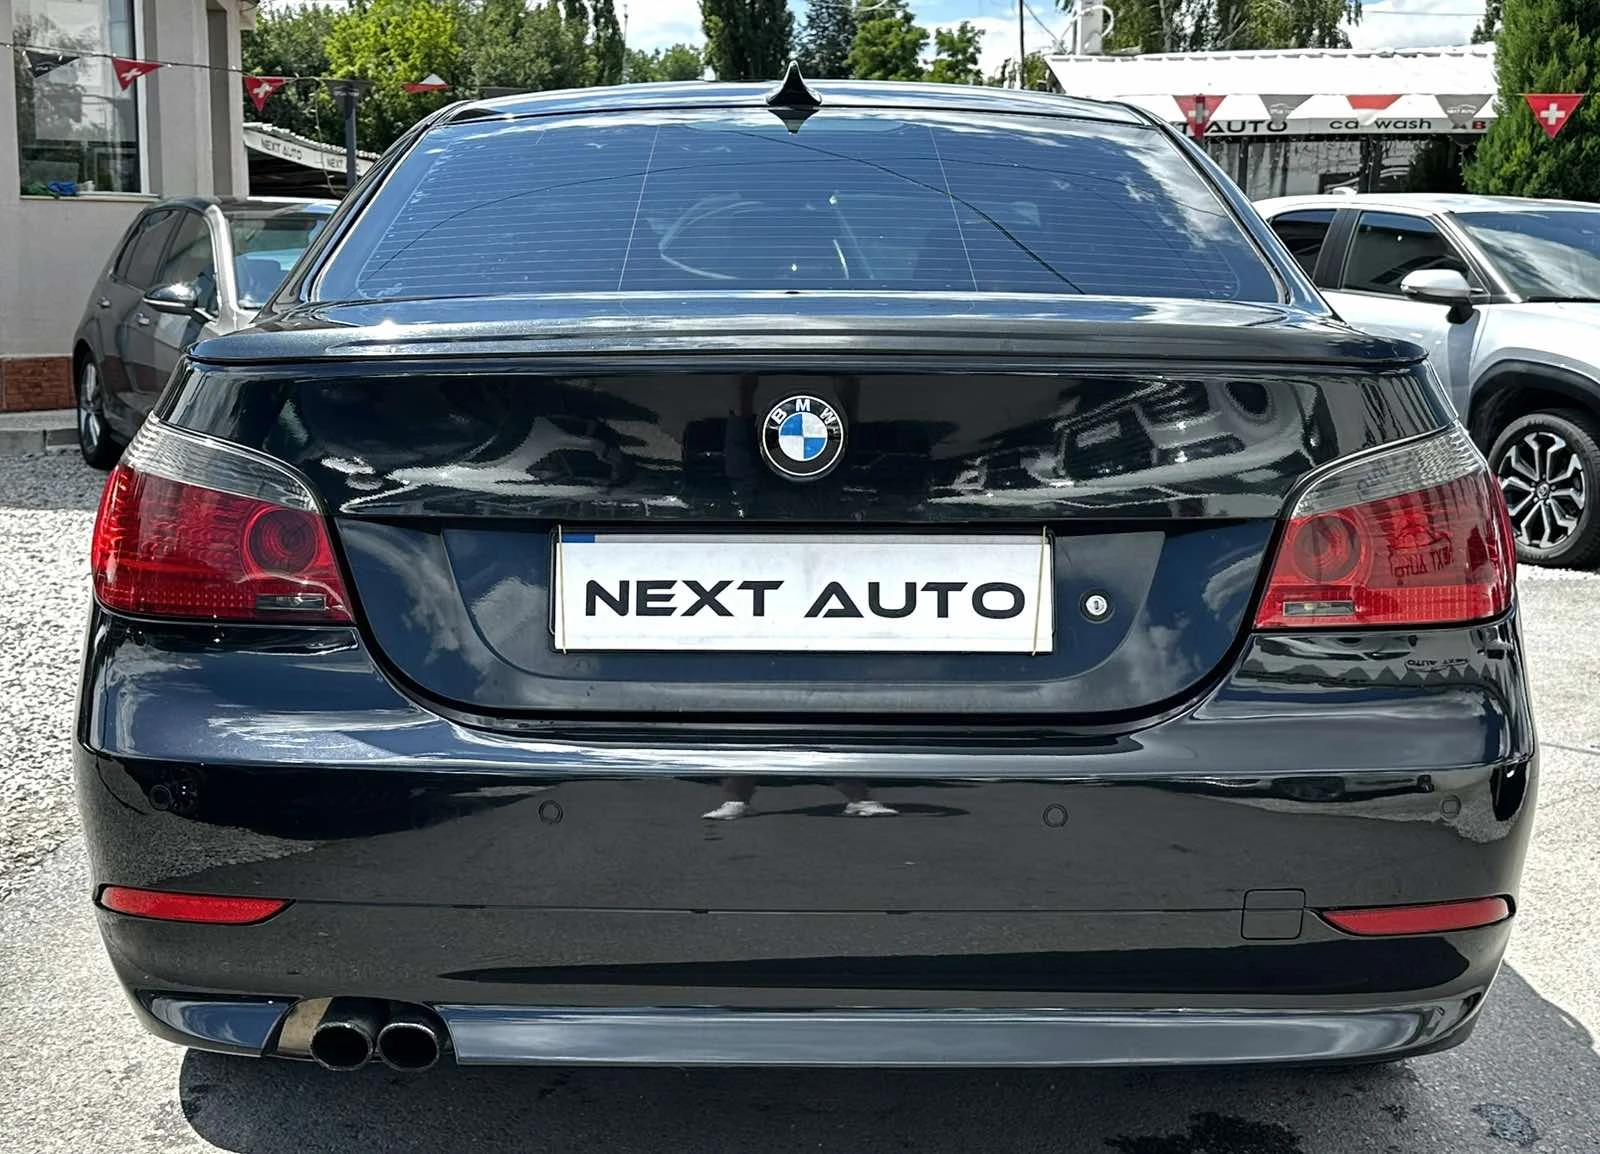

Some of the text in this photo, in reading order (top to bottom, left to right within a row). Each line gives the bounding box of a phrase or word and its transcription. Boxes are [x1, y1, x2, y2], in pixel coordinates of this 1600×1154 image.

[1205, 120, 1288, 133] AUTO
[1329, 118, 1432, 130] ca wash
[770, 398, 836, 425] BMW
[585, 579, 1026, 620] NEXT AUTO
